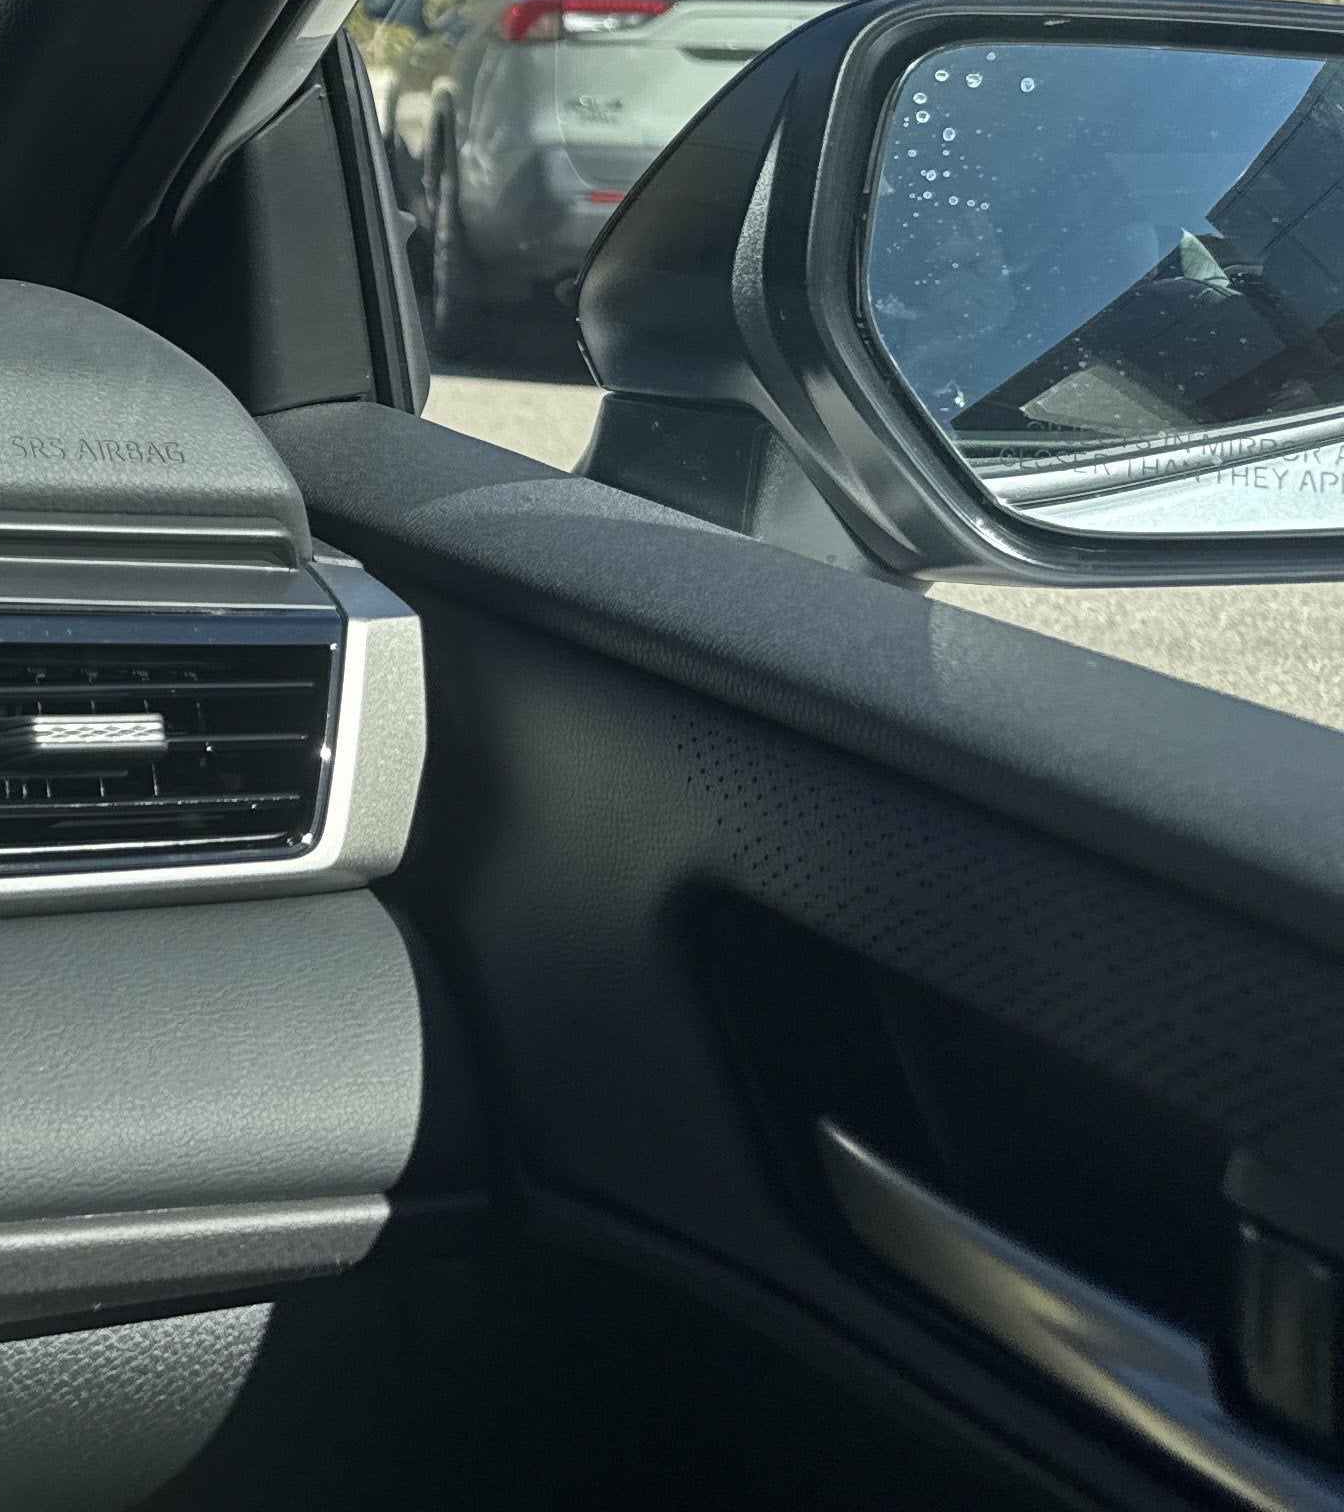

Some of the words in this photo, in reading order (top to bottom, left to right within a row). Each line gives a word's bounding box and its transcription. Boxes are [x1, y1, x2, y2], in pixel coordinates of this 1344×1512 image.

[11, 437, 66, 461] SRS
[77, 439, 187, 465] AIRBAG
[1212, 463, 1290, 490] THEY
[1298, 469, 1344, 495] AP
